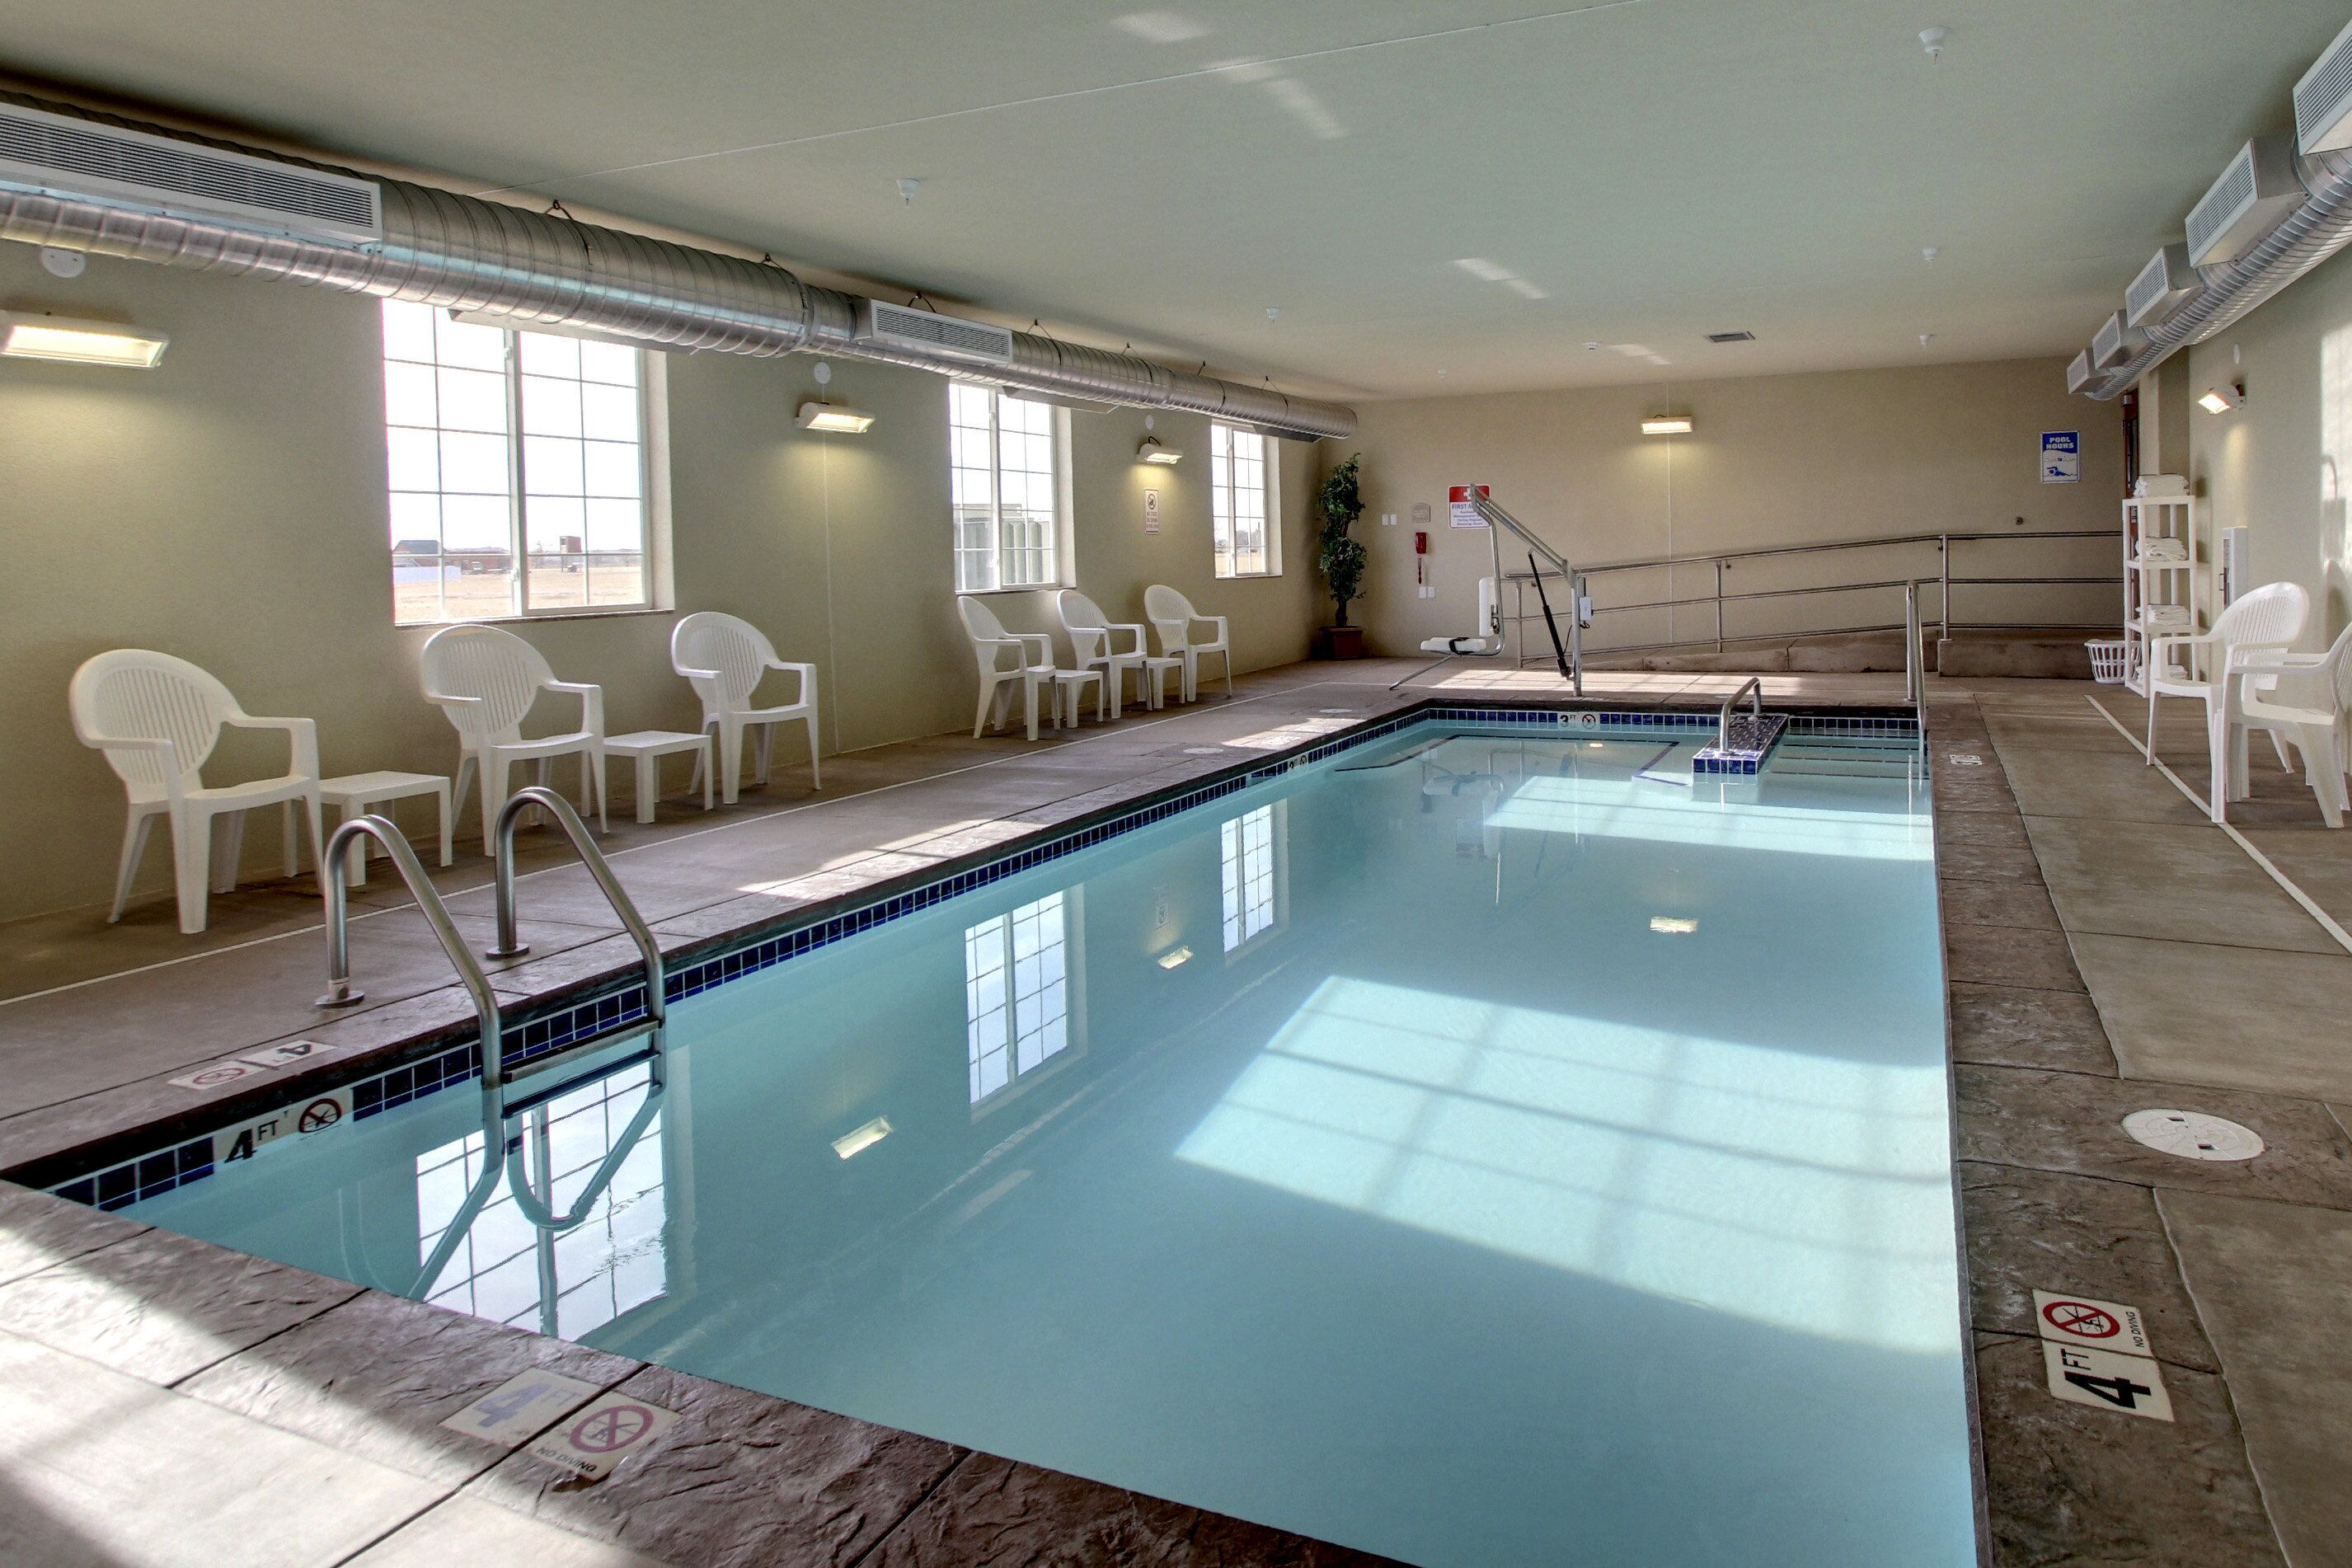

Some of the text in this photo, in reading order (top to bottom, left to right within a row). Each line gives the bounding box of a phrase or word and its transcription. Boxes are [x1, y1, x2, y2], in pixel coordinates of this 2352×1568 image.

[276, 1044, 312, 1056] 4
[224, 1128, 257, 1163] 4
[258, 1120, 279, 1140] FT
[2125, 1312, 2144, 1348] NO DIVING
[2060, 1348, 2152, 1410] 4 FT
[473, 1383, 553, 1428] 4
[536, 1446, 597, 1472] NO DIVING
